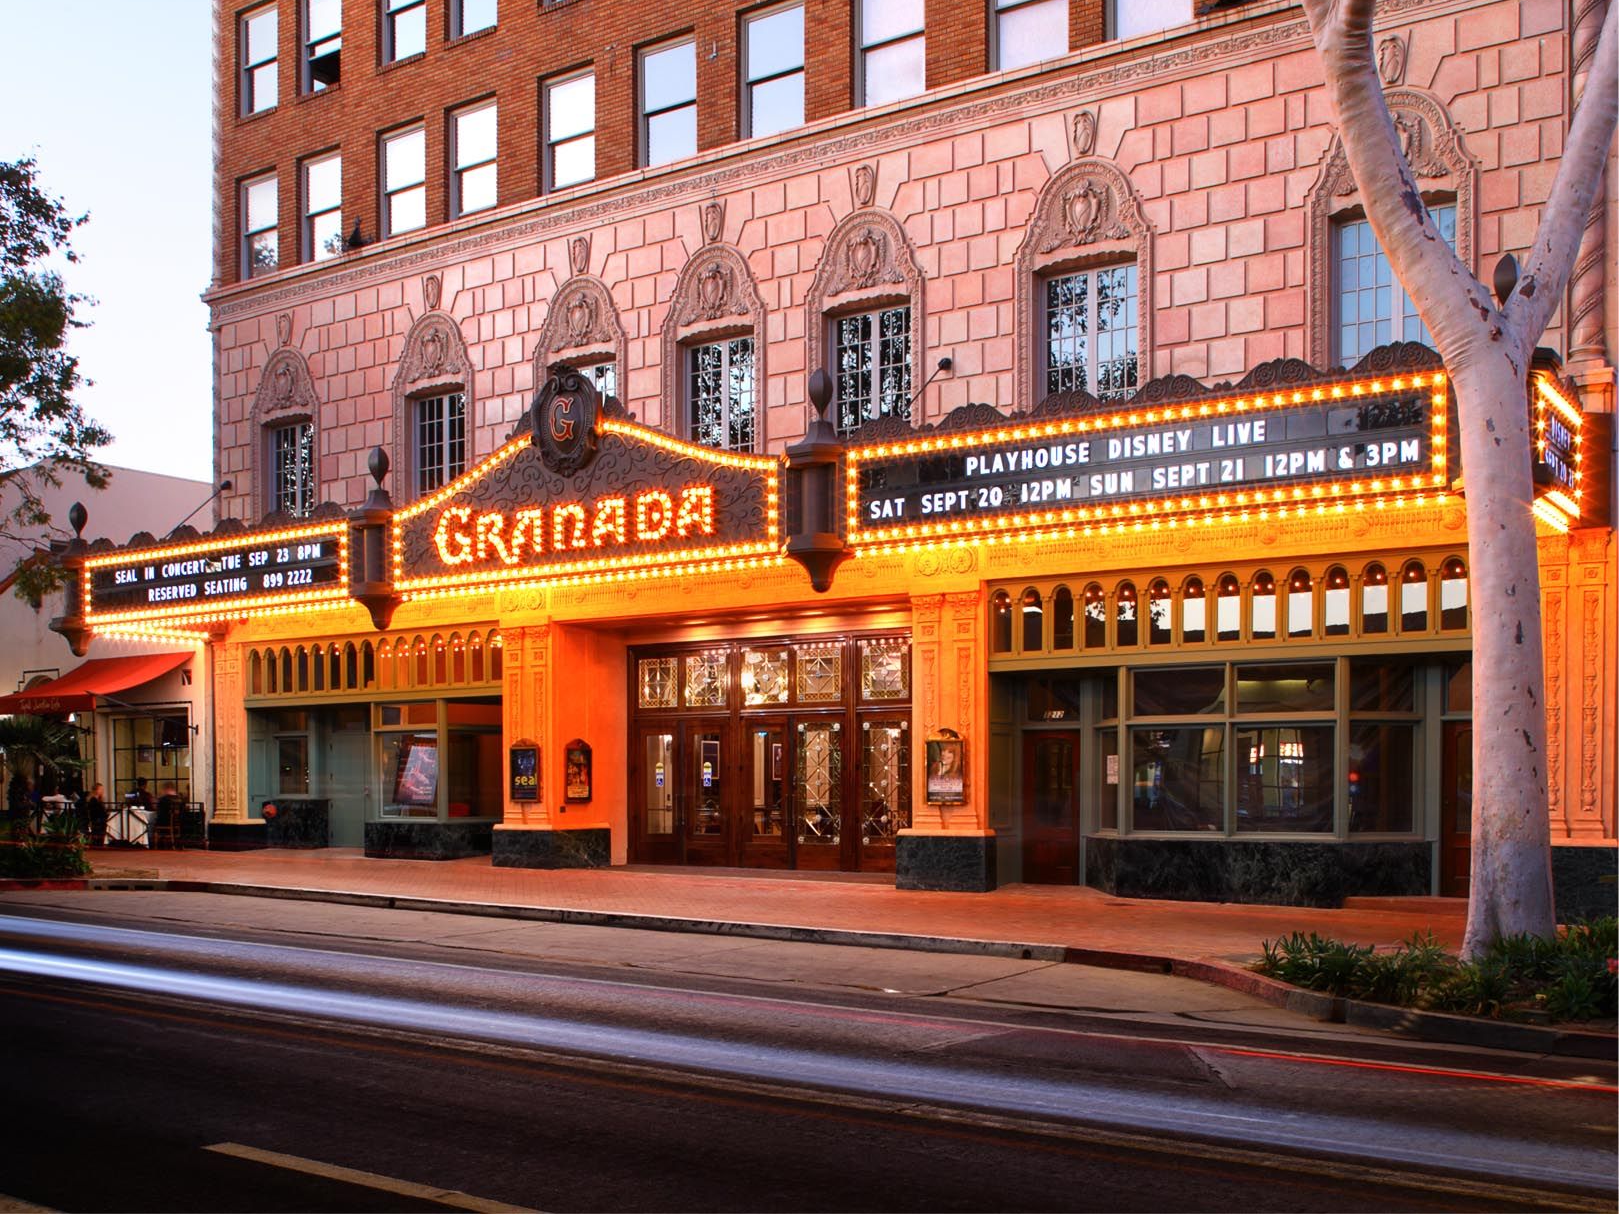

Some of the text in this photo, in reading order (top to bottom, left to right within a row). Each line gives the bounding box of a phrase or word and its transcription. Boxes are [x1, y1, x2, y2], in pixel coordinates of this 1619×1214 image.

[550, 397, 575, 442] G
[966, 420, 1266, 476] PLAYHOUSE DISNEY LIVE
[870, 439, 1419, 519] SAT SEPT 20 12PM SUN SEPT 21 12PM & 3PM
[434, 482, 716, 566] GRANADA
[115, 543, 321, 584] SEAL IN CONCERT TUE SEP 23 8PM
[148, 569, 312, 602] RESERVED SEATING 899 2222
